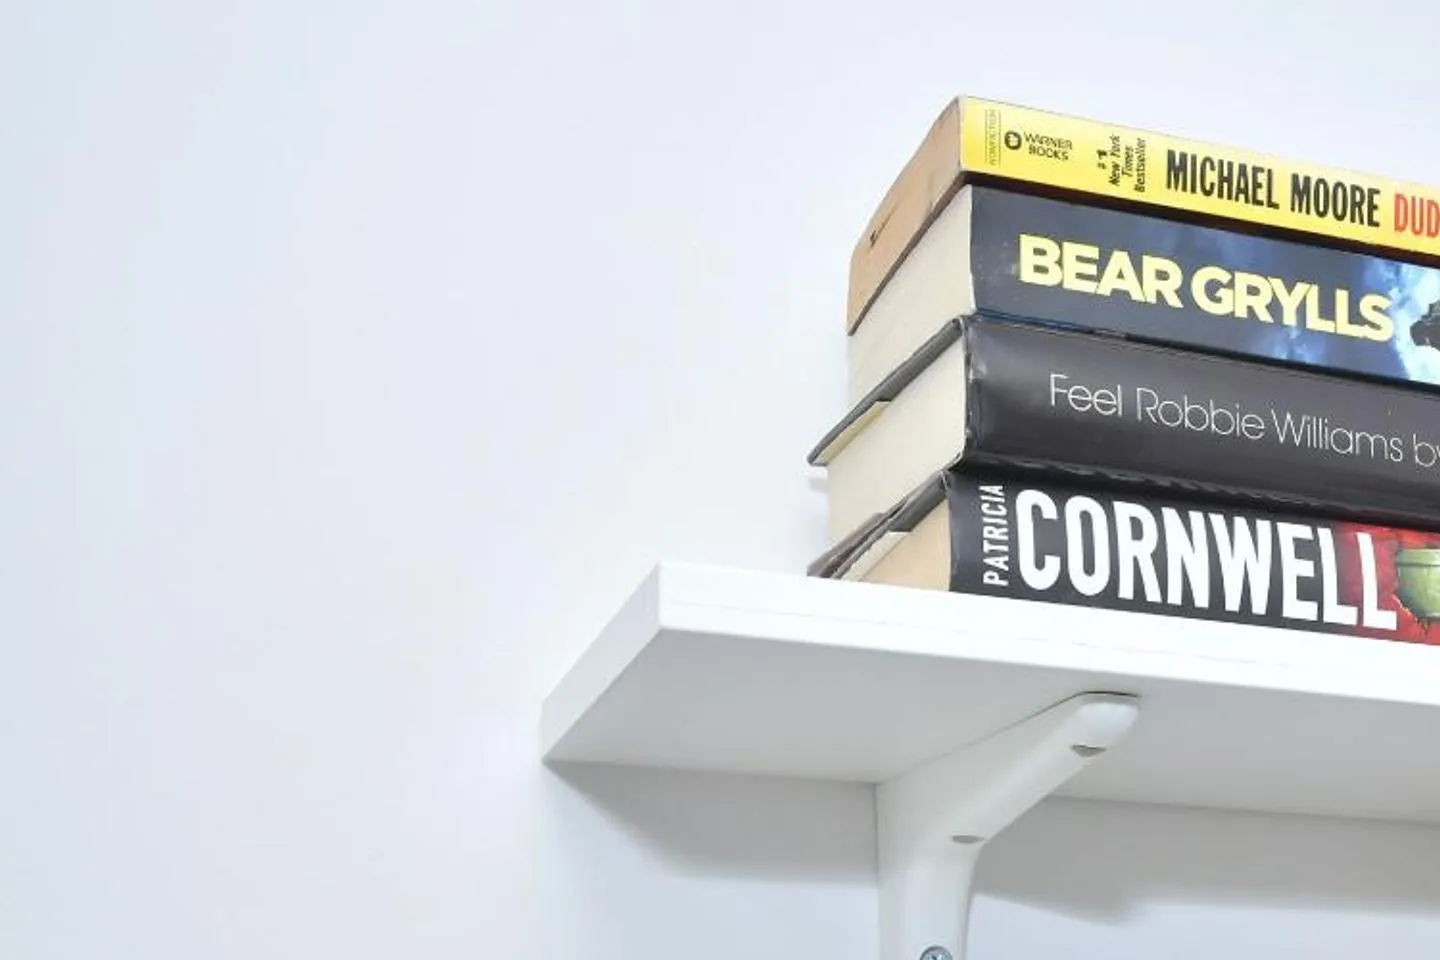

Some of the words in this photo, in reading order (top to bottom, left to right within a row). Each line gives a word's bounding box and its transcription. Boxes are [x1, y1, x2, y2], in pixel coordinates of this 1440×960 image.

[1023, 131, 1073, 150] WARNER
[1029, 144, 1069, 161] BOOKS
[1110, 134, 1121, 159] York
[1121, 145, 1134, 177] Times
[1133, 137, 1147, 193] Bestseller
[1109, 161, 1120, 186] New
[1166, 149, 1280, 211] MICHAEL
[1290, 173, 1381, 228] MOORE
[1019, 233, 1184, 308] BEAR
[1190, 265, 1393, 342] GRYLLS
[1049, 373, 1122, 418] Feel
[1136, 386, 1265, 440] Robbie
[1271, 407, 1403, 463] Williams
[977, 485, 1010, 588] PATRICIA
[1015, 488, 1398, 632] CORNWELL
